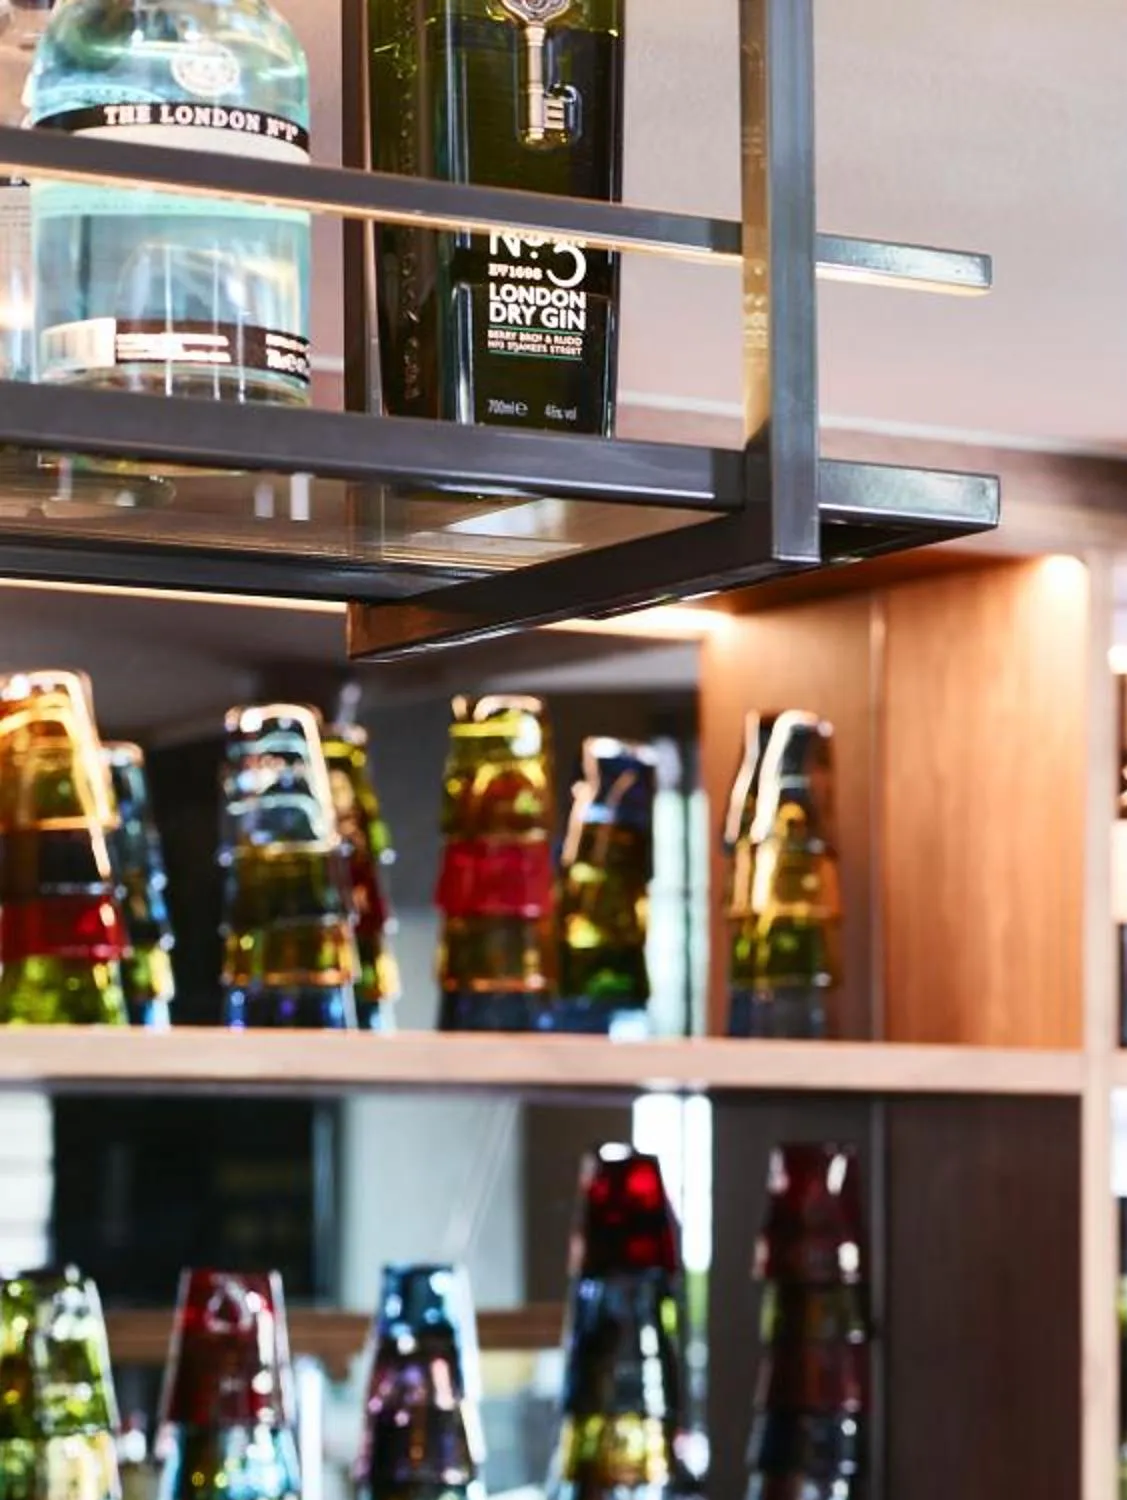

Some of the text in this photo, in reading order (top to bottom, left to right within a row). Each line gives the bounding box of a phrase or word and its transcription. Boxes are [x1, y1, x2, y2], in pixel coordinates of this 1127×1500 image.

[104, 105, 151, 125] THE
[160, 105, 260, 132] LONDON
[489, 282, 587, 309] LONDON
[489, 301, 587, 331] DRY GIN
